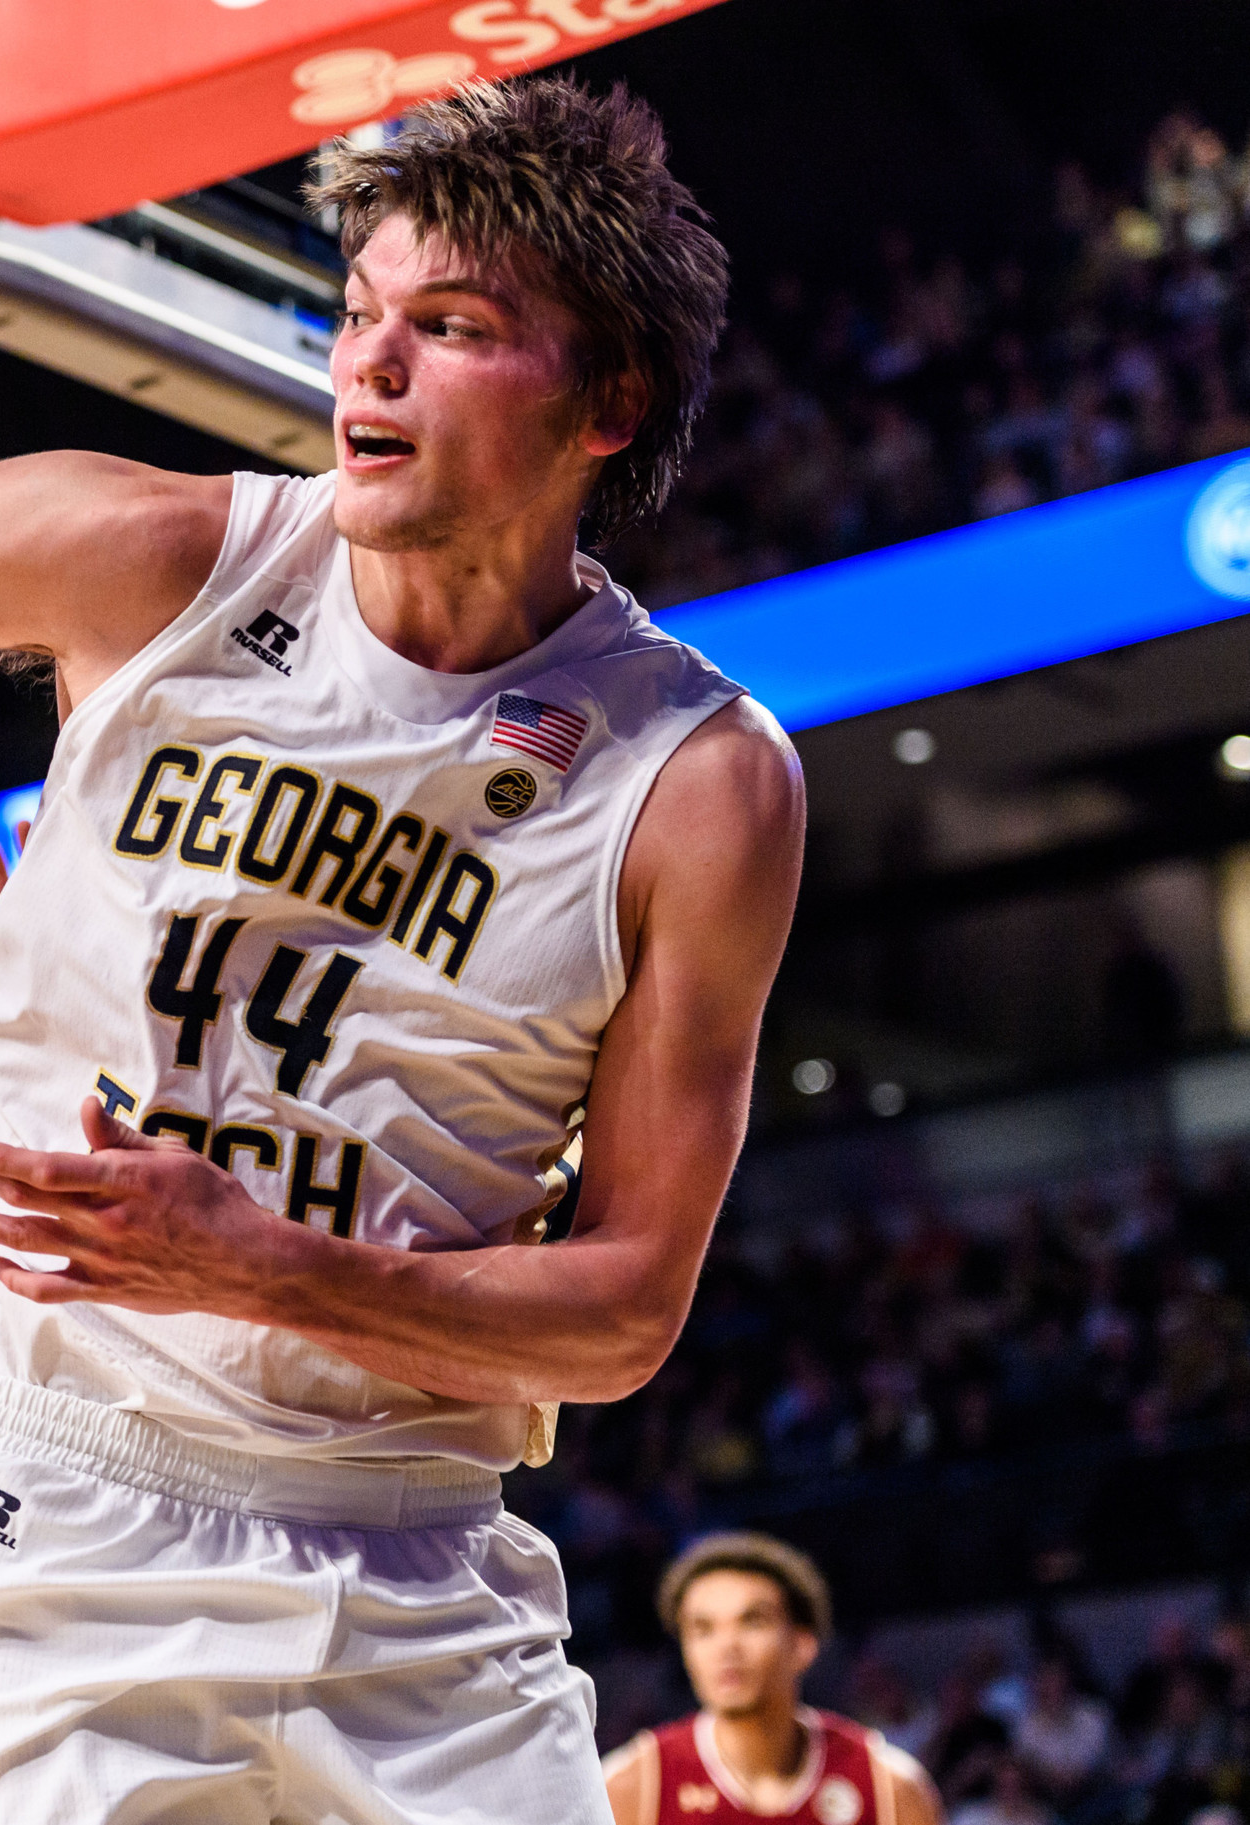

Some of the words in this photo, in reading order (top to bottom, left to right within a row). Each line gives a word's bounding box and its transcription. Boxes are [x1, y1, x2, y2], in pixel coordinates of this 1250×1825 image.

[230, 627, 292, 677] RUSSELL
[494, 783, 533, 803] ACC
[112, 743, 500, 986] GEORGIA
[147, 912, 366, 1099] 44
